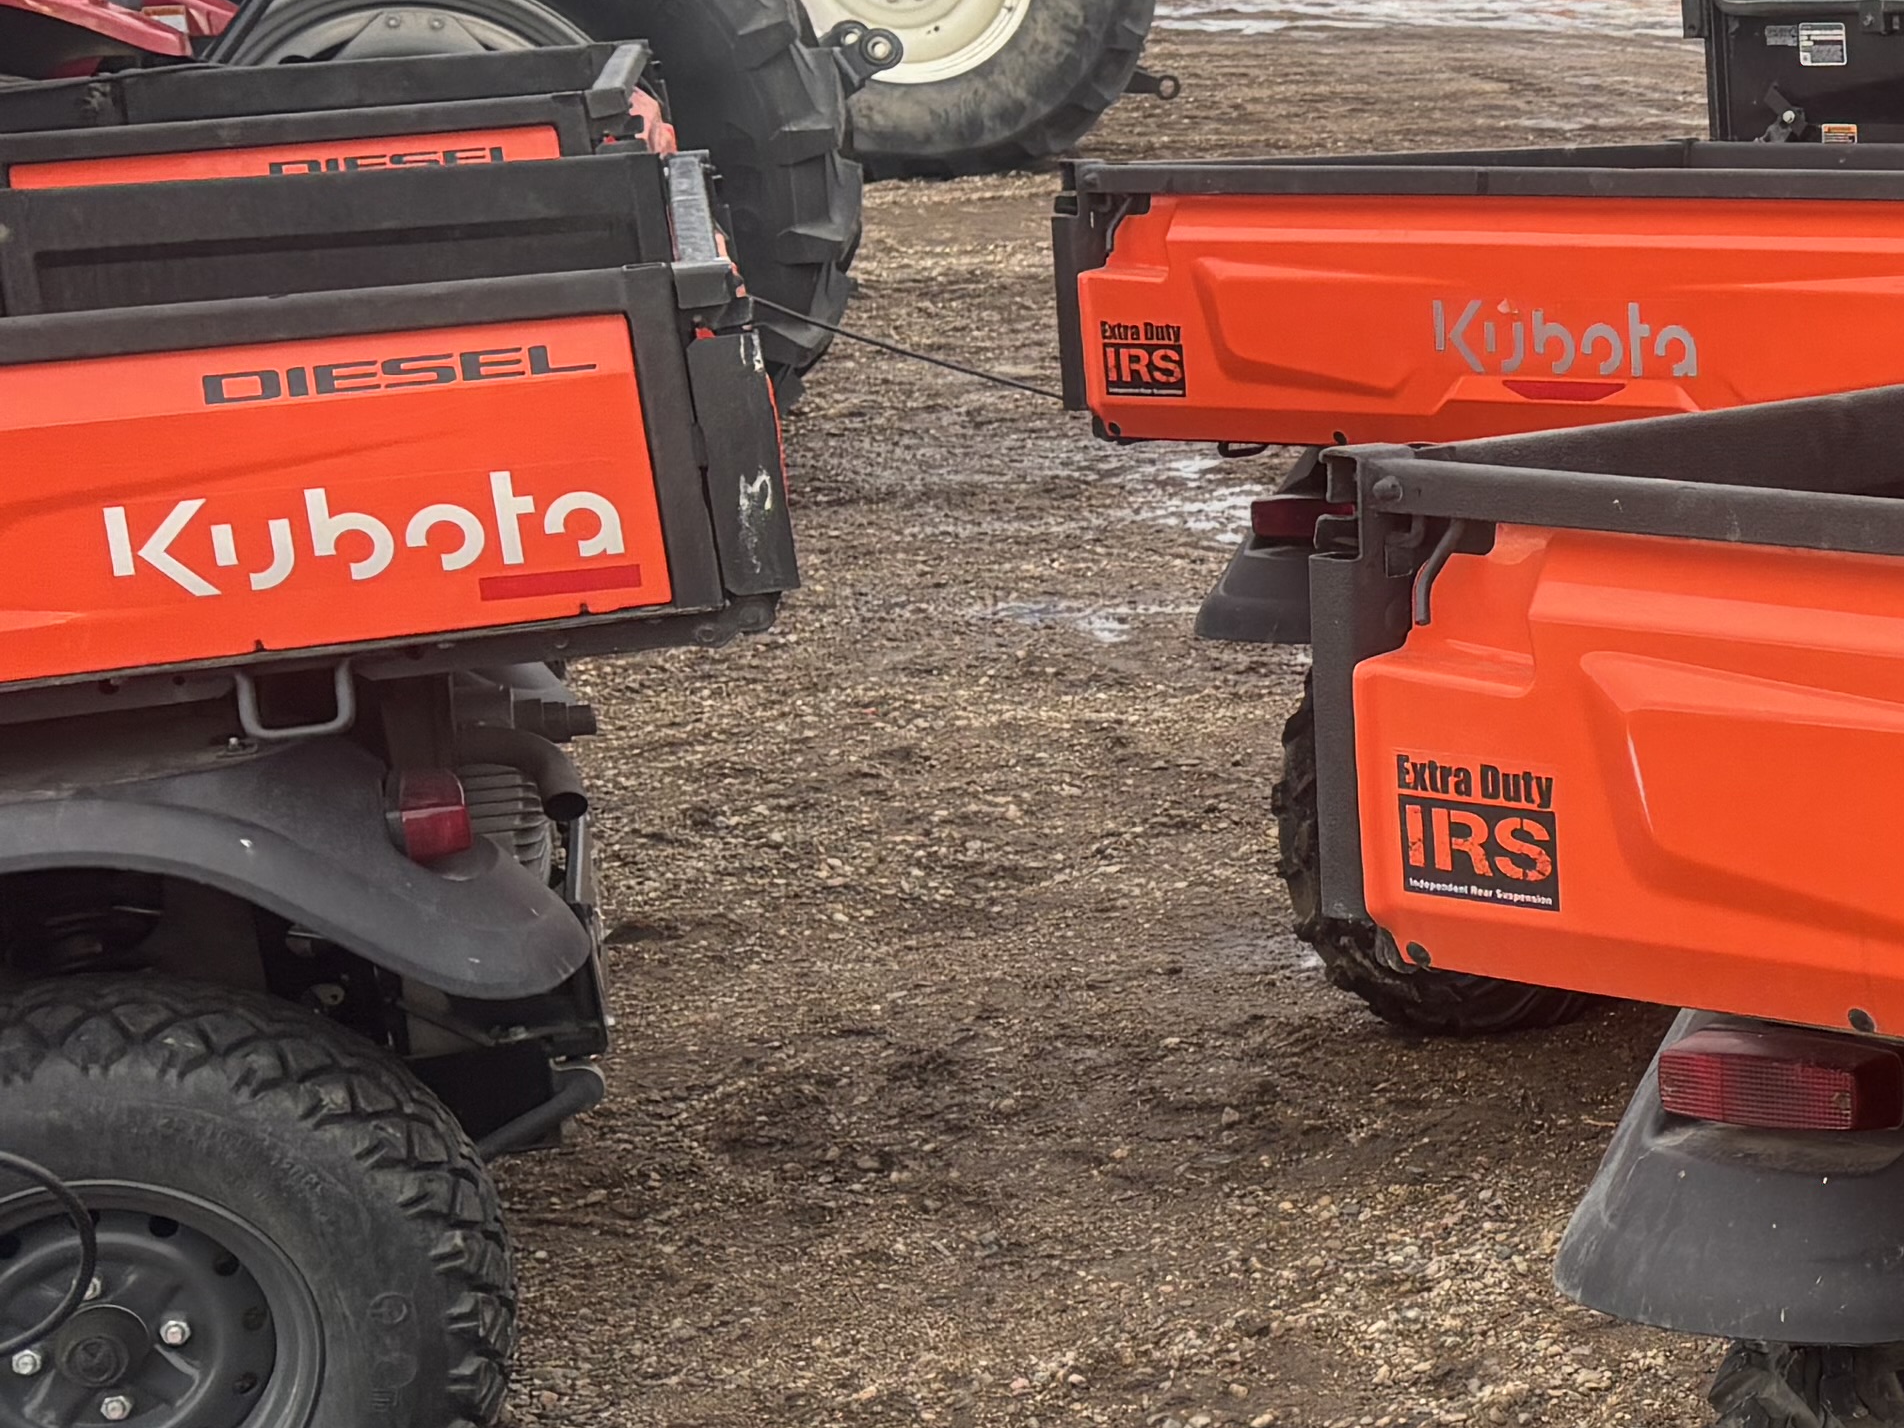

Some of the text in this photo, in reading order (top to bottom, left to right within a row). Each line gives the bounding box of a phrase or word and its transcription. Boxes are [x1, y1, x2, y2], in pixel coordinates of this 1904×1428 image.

[1100, 320, 1182, 345] Extra Duty
[1432, 298, 1697, 377] Kubota
[202, 345, 597, 405] DIESEL
[1105, 347, 1182, 383] IRS
[103, 470, 625, 596] Kubota
[1397, 754, 1553, 809] Extra Duty
[1406, 804, 1552, 882] IRS
[1409, 877, 1553, 906] Independent Rear Suspension
